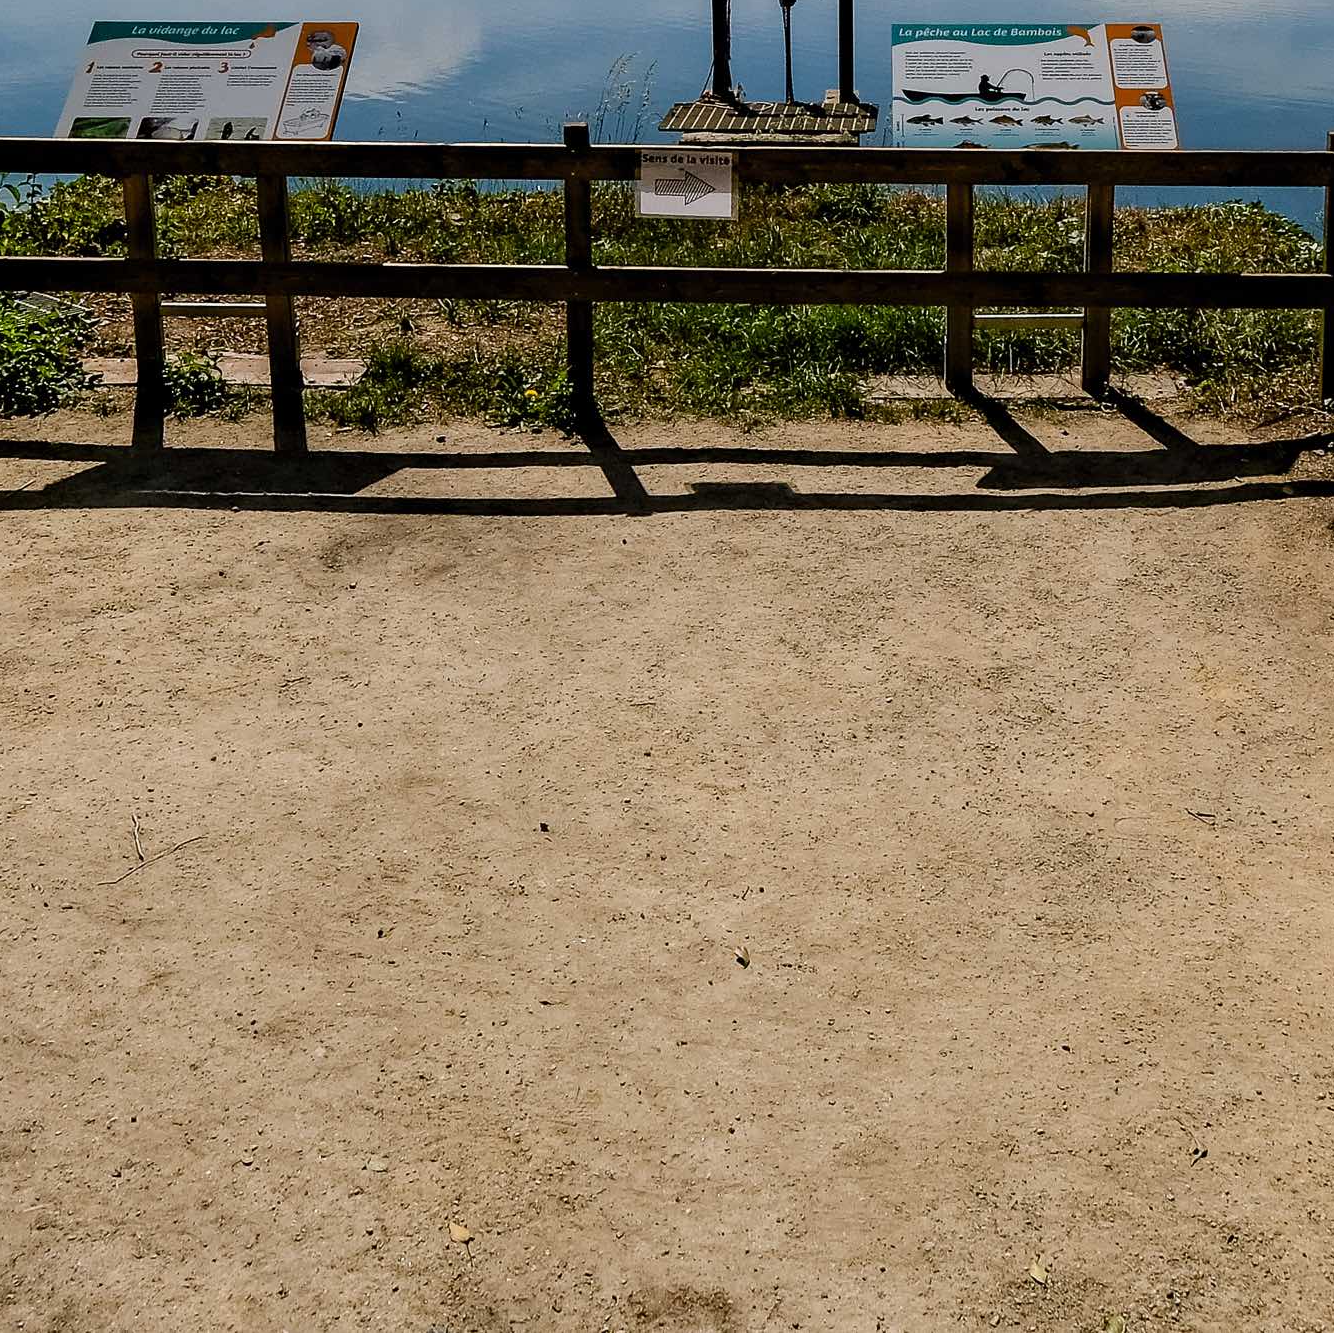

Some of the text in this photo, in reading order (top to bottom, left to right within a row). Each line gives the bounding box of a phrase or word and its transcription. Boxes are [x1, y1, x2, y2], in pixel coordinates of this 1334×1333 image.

[132, 25, 240, 37] La vidange du lac
[898, 27, 1062, 38] La pêche au Lac de Bambois
[85, 61, 95, 73] 1
[148, 61, 163, 73] 2
[218, 61, 229, 74] 3
[642, 153, 731, 165] Sens de la visite
